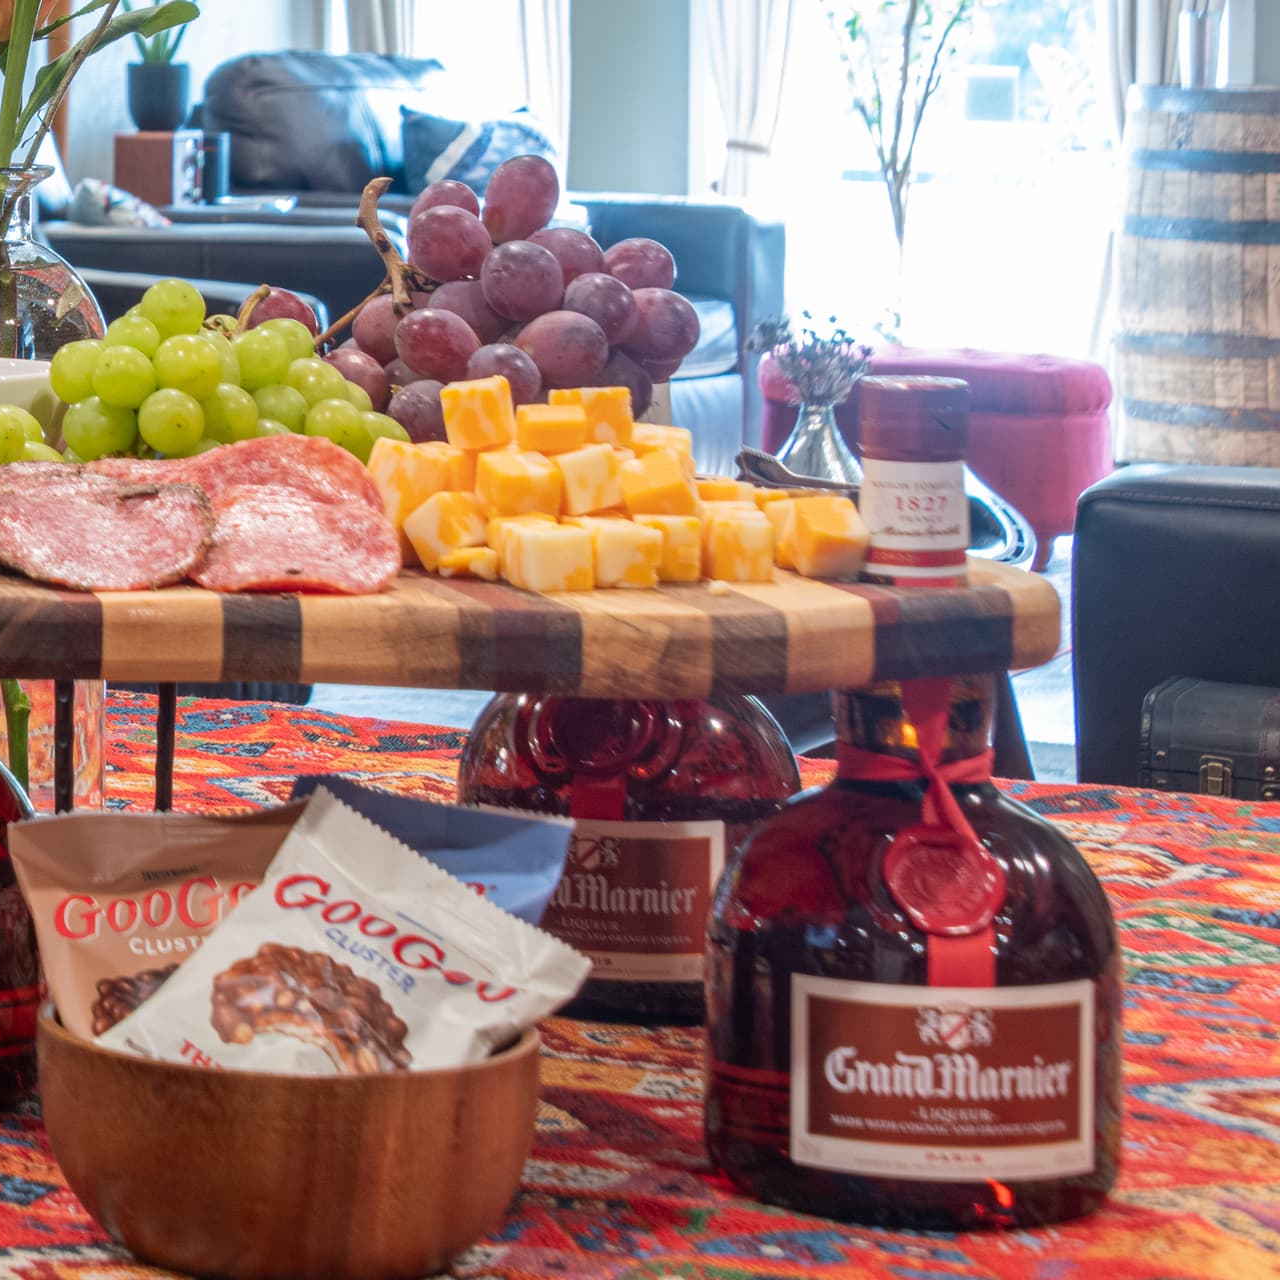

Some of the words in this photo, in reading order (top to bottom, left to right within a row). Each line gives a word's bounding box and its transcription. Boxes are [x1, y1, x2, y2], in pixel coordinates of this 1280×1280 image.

[895, 495, 948, 512] 1827
[568, 873, 696, 915] Marnier
[128, 935, 212, 956] CLUST
[324, 926, 418, 994] CLUSTER
[824, 1045, 933, 1099] Grand
[931, 1052, 1072, 1101] Marnier
